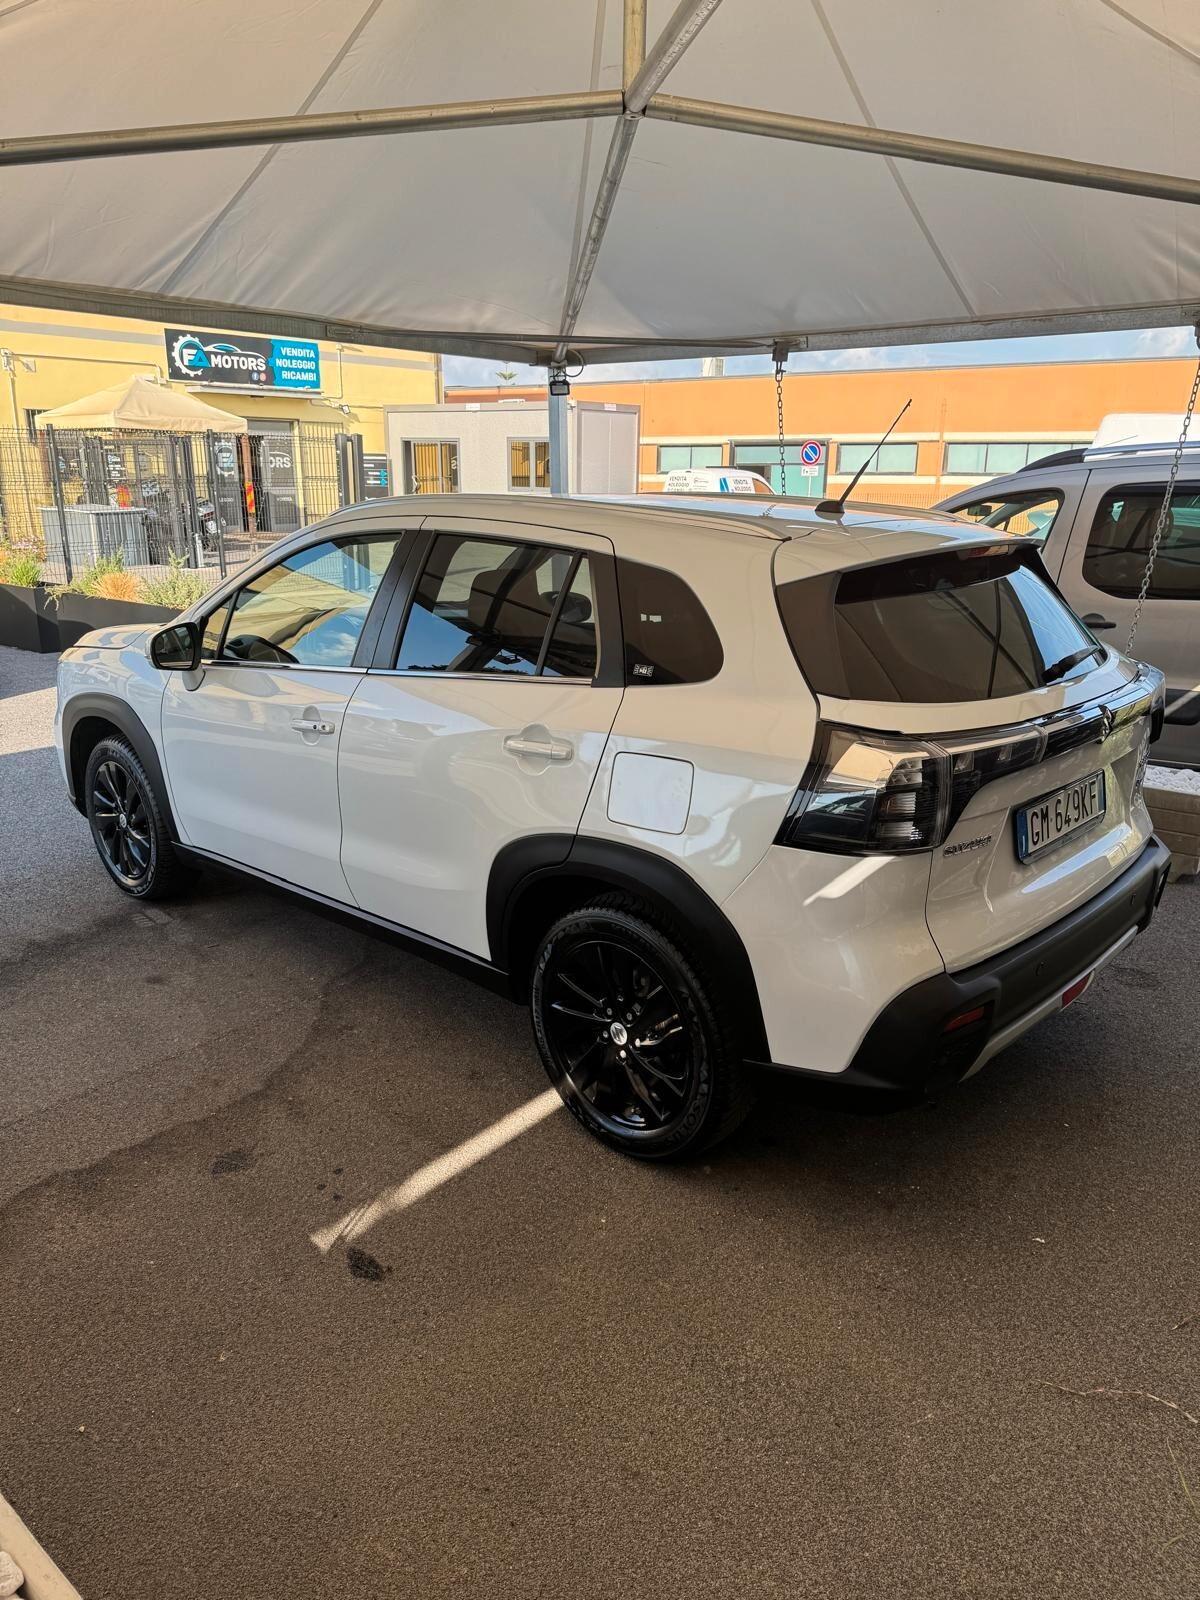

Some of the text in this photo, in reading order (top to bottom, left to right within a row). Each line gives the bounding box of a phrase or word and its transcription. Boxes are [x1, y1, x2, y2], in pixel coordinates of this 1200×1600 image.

[280, 347, 316, 358] VENDITA
[183, 348, 267, 371] FA MOTORS
[275, 358, 316, 369] NOLEGGIO
[281, 371, 317, 381] RICAMBI
[1030, 780, 1096, 846] GM 649KF
